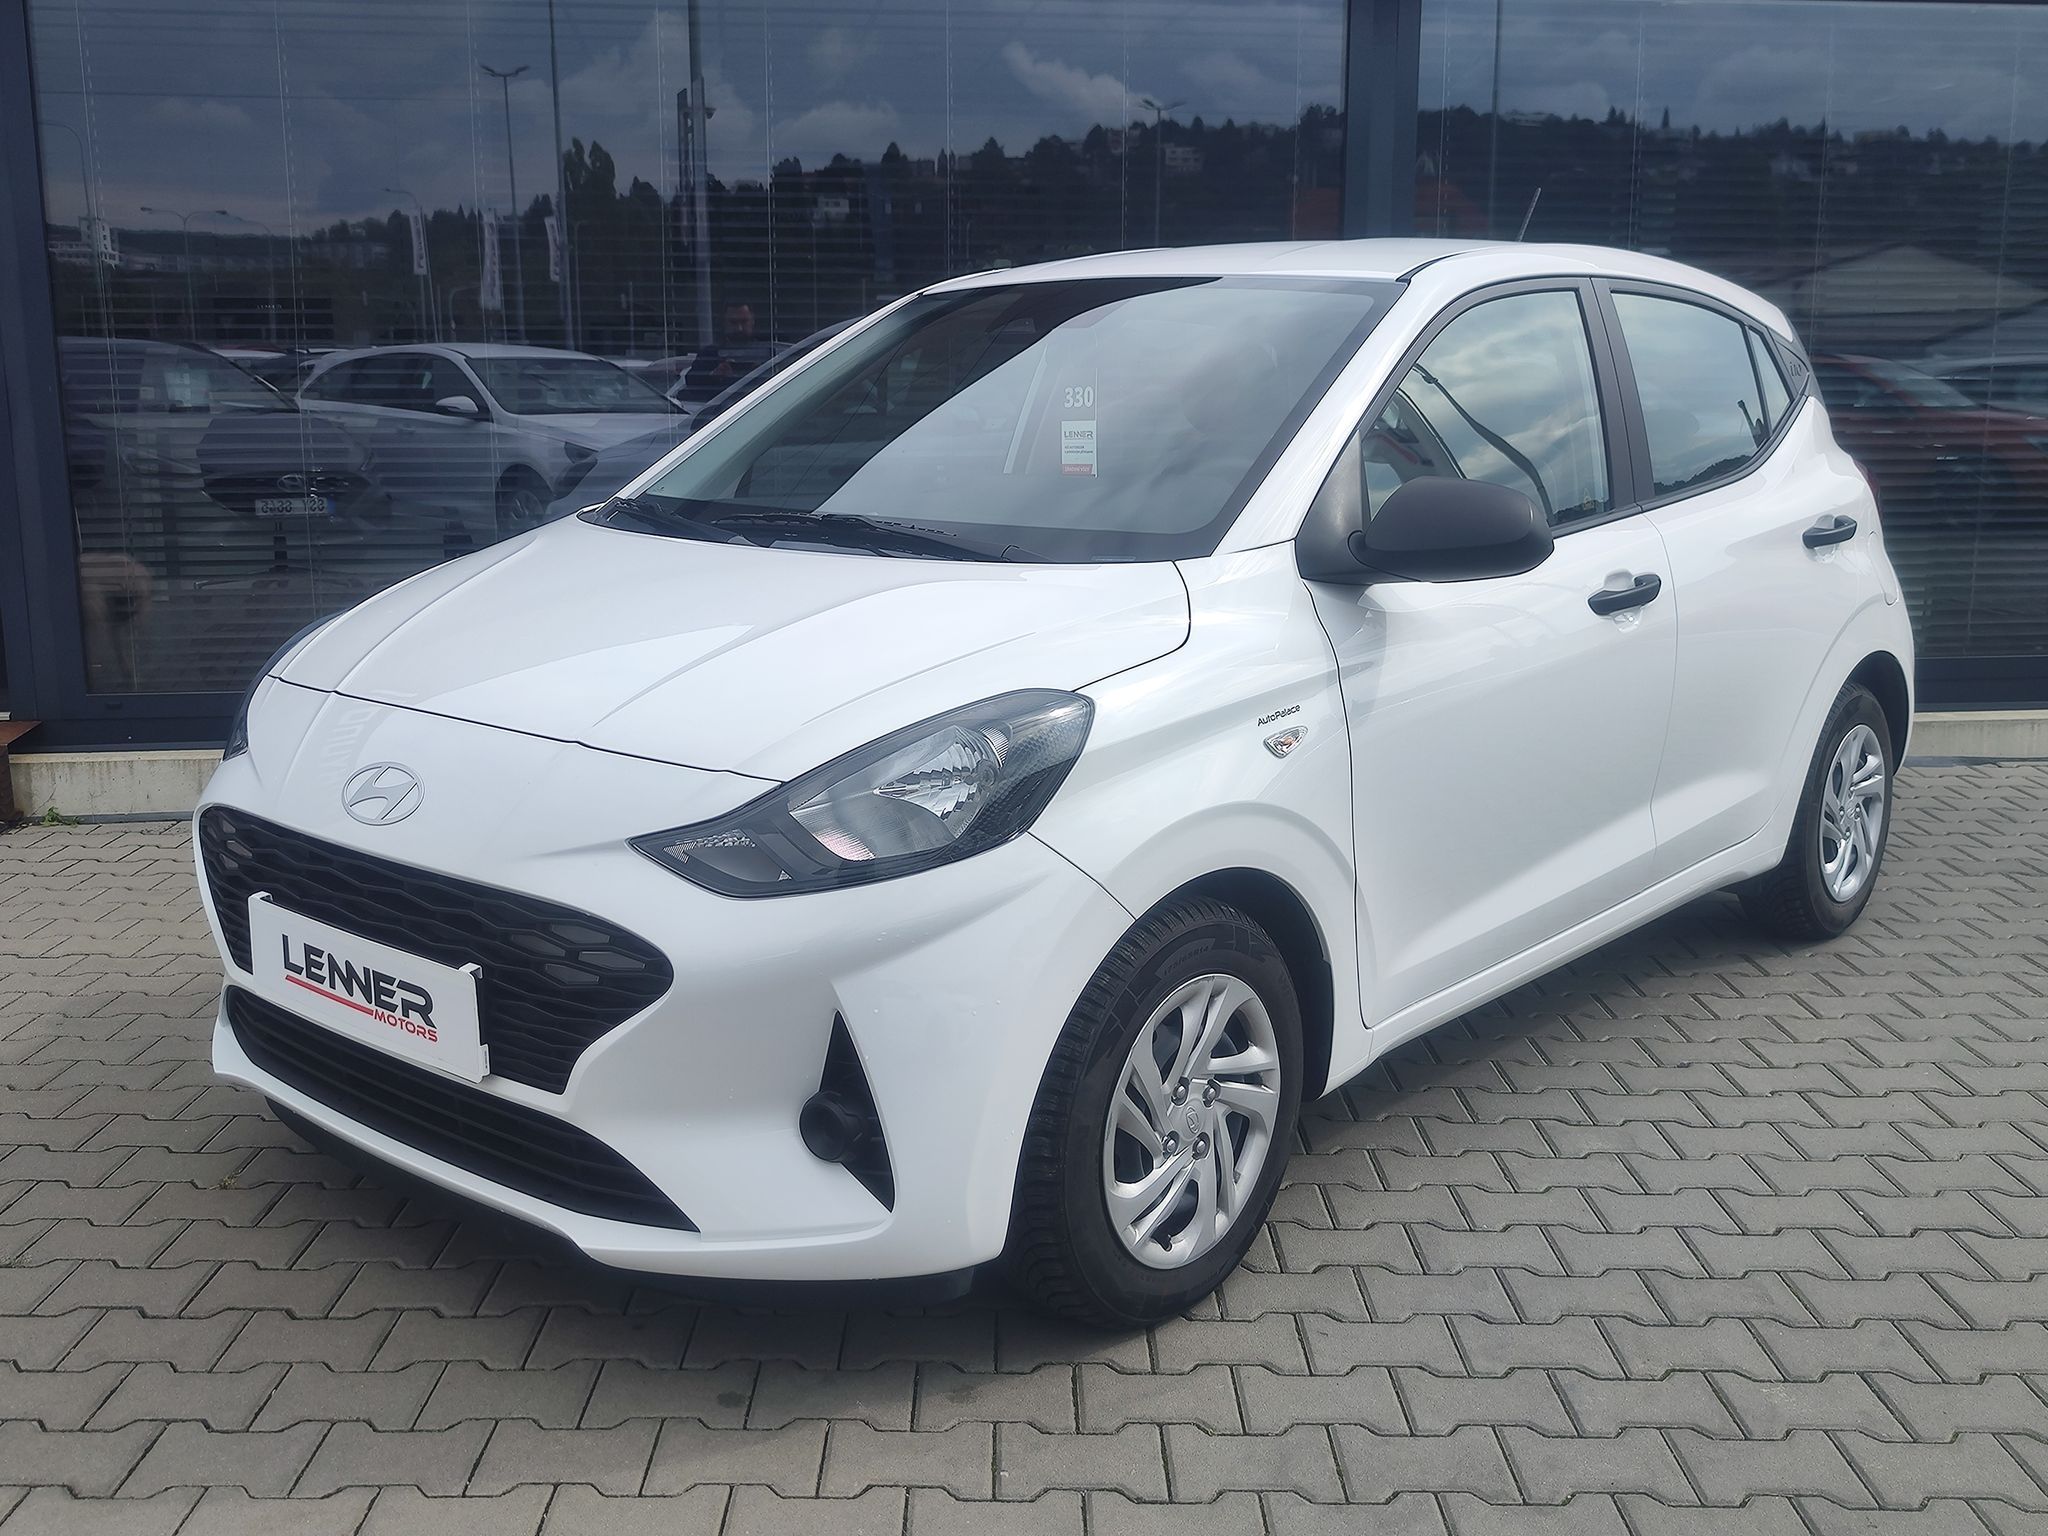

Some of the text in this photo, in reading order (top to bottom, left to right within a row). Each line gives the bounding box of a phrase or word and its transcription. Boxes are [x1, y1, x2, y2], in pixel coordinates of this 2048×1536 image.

[1064, 386, 1094, 408] 330
[1257, 704, 1301, 727] AutoPalace
[282, 933, 437, 1030] LENNER
[374, 1008, 438, 1043] MOTORS
